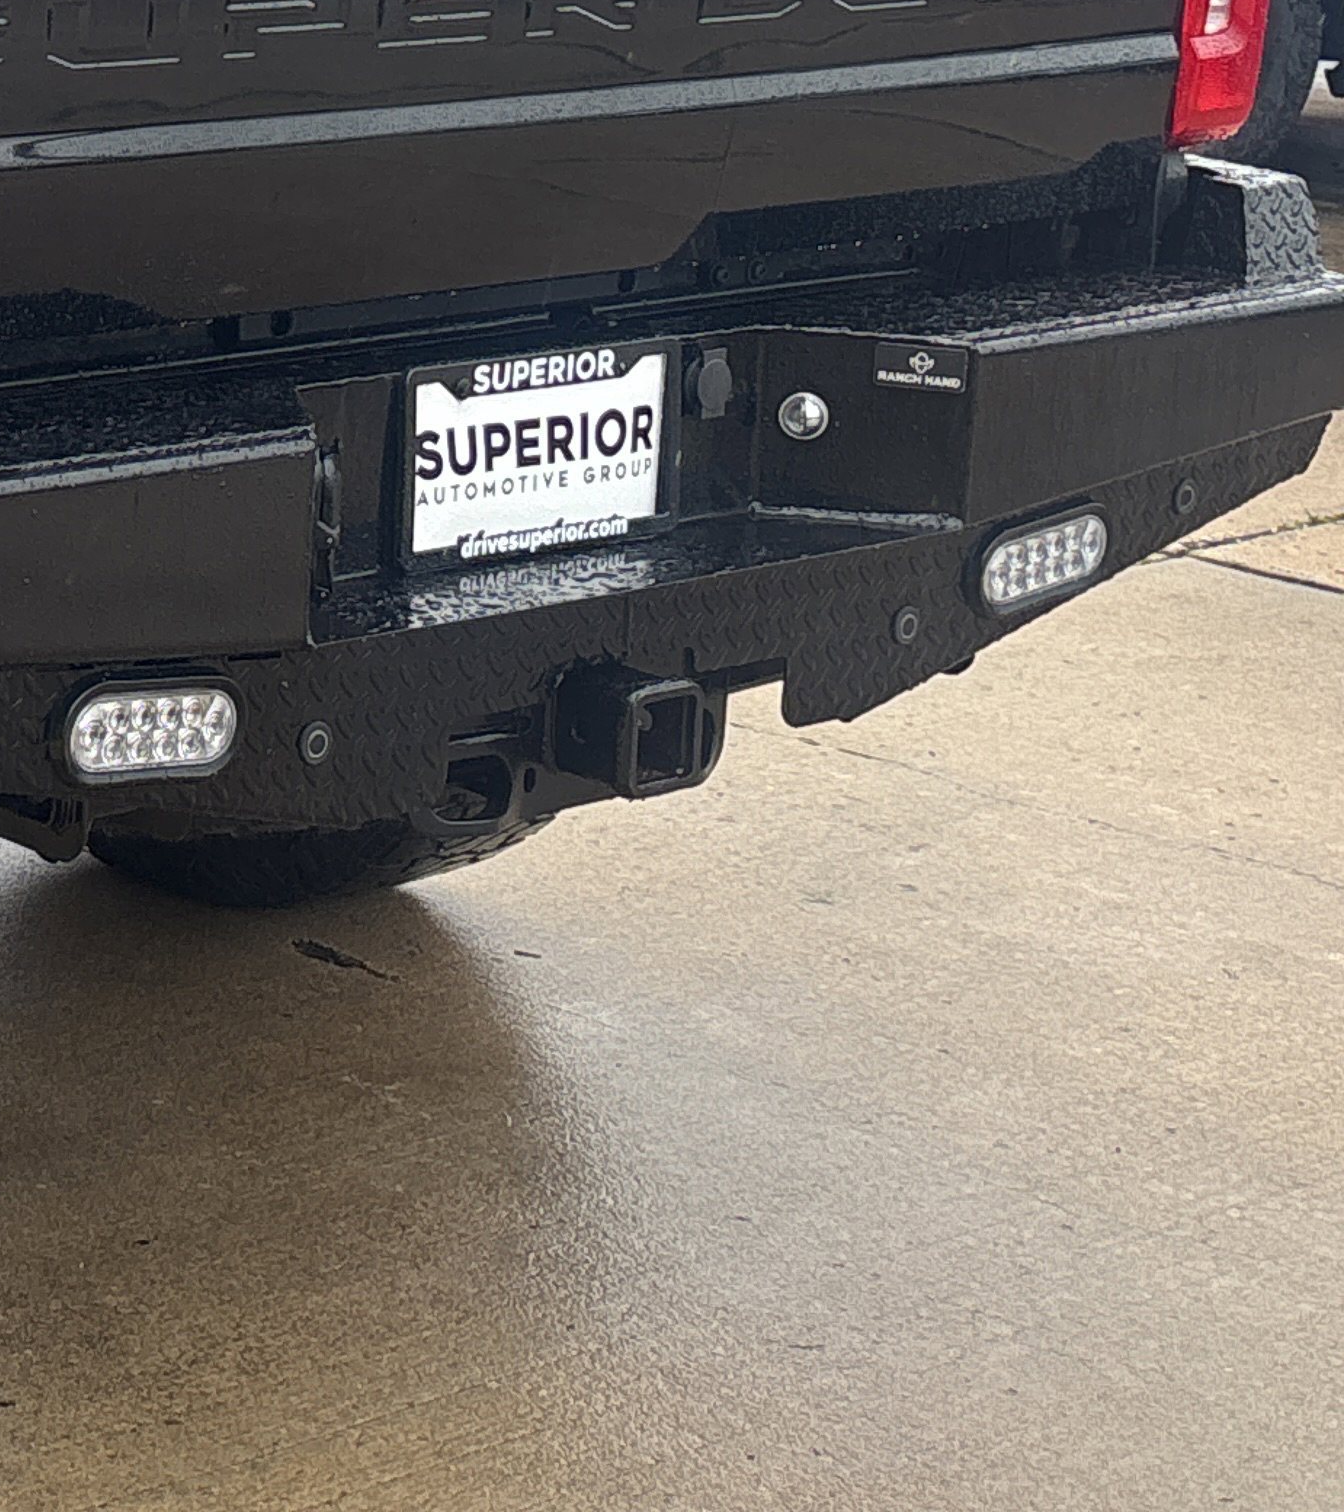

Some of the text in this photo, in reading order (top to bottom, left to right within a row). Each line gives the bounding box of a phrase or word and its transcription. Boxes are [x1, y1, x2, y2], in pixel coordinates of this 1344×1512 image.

[472, 348, 616, 394] SUPERIOR
[876, 369, 961, 389] RANCH HAND
[414, 404, 654, 481] SUPERIOR
[416, 457, 653, 508] AUTOMOTIVE GROUP
[460, 516, 629, 560] drivesuperior.com
